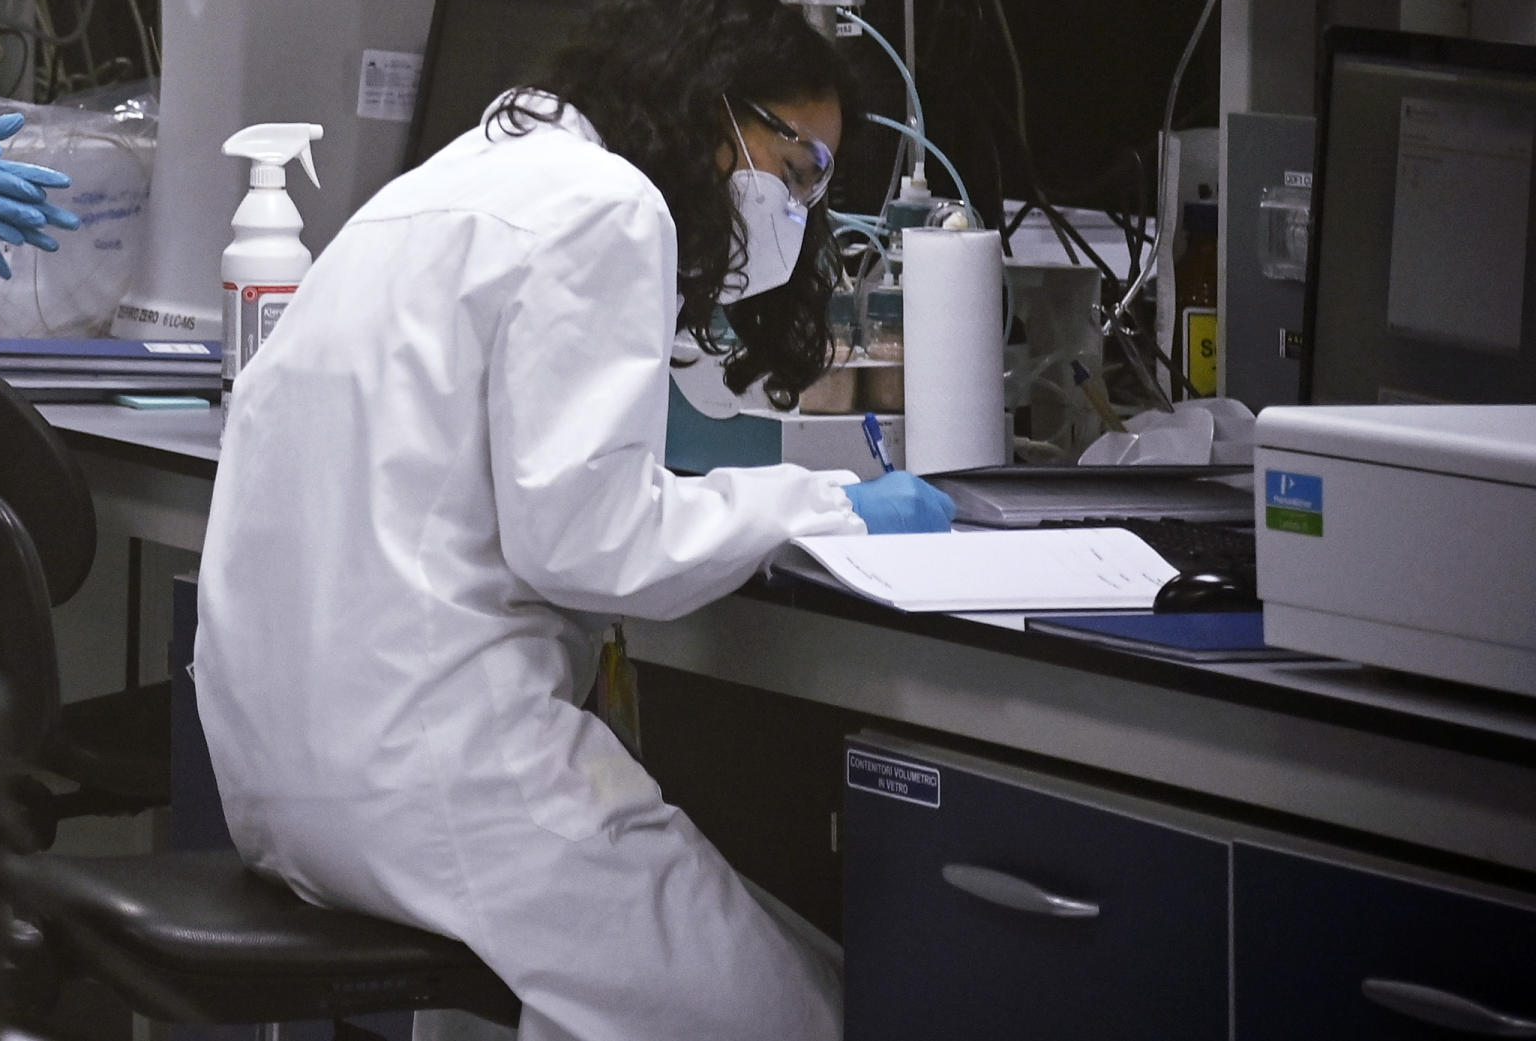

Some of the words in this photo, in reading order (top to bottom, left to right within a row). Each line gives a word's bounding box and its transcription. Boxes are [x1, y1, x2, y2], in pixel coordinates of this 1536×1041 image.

[850, 756, 893, 776] CONTENITORI
[893, 767, 938, 787] VOLUMETRICI
[886, 779, 909, 794] VETRO
